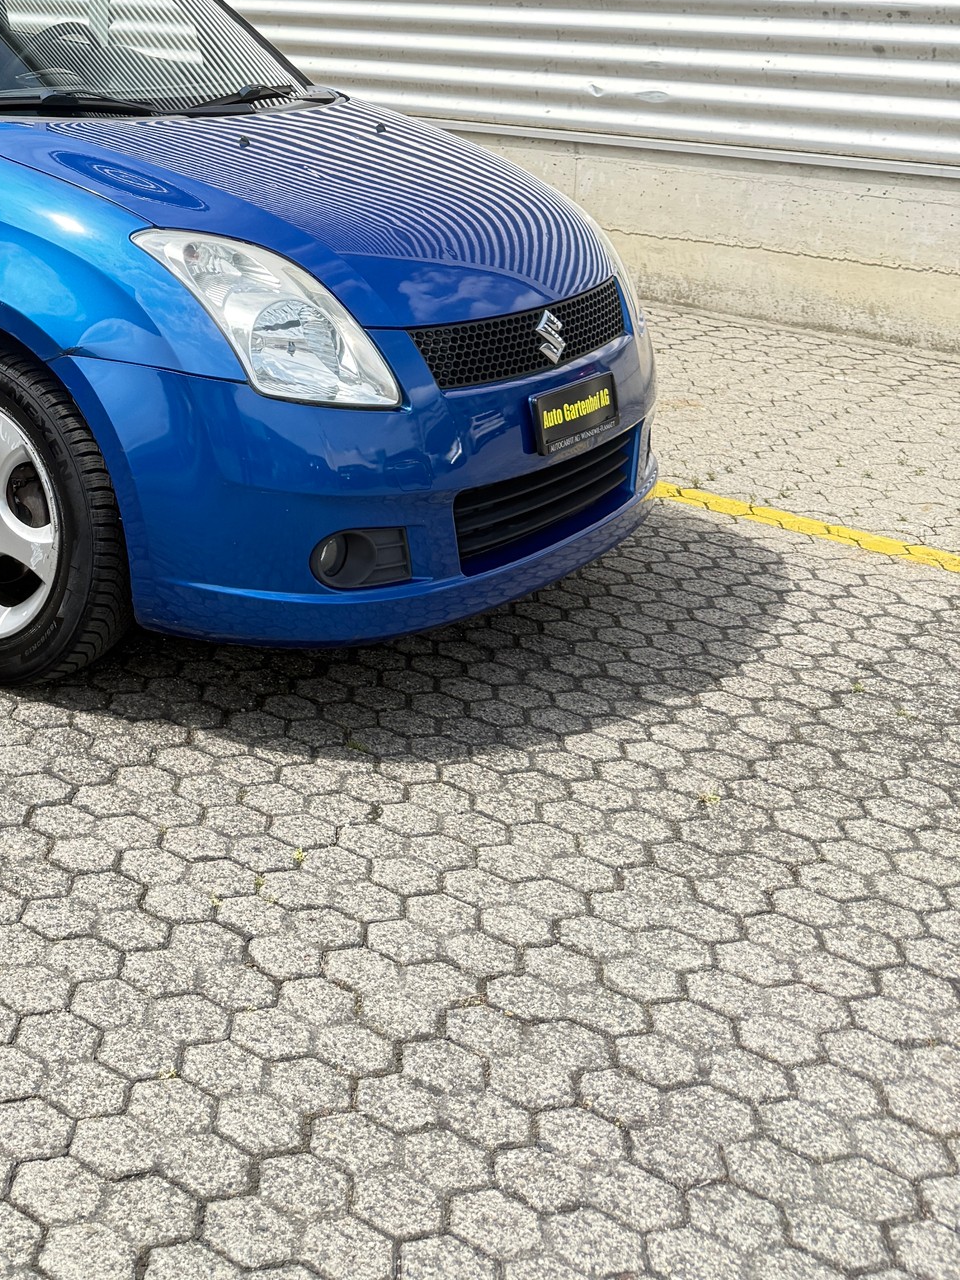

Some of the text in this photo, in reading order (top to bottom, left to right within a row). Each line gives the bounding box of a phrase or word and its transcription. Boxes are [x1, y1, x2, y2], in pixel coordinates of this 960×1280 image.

[6, 385, 74, 483] NEXEN
[543, 388, 610, 429] Auto Gartenhof AG
